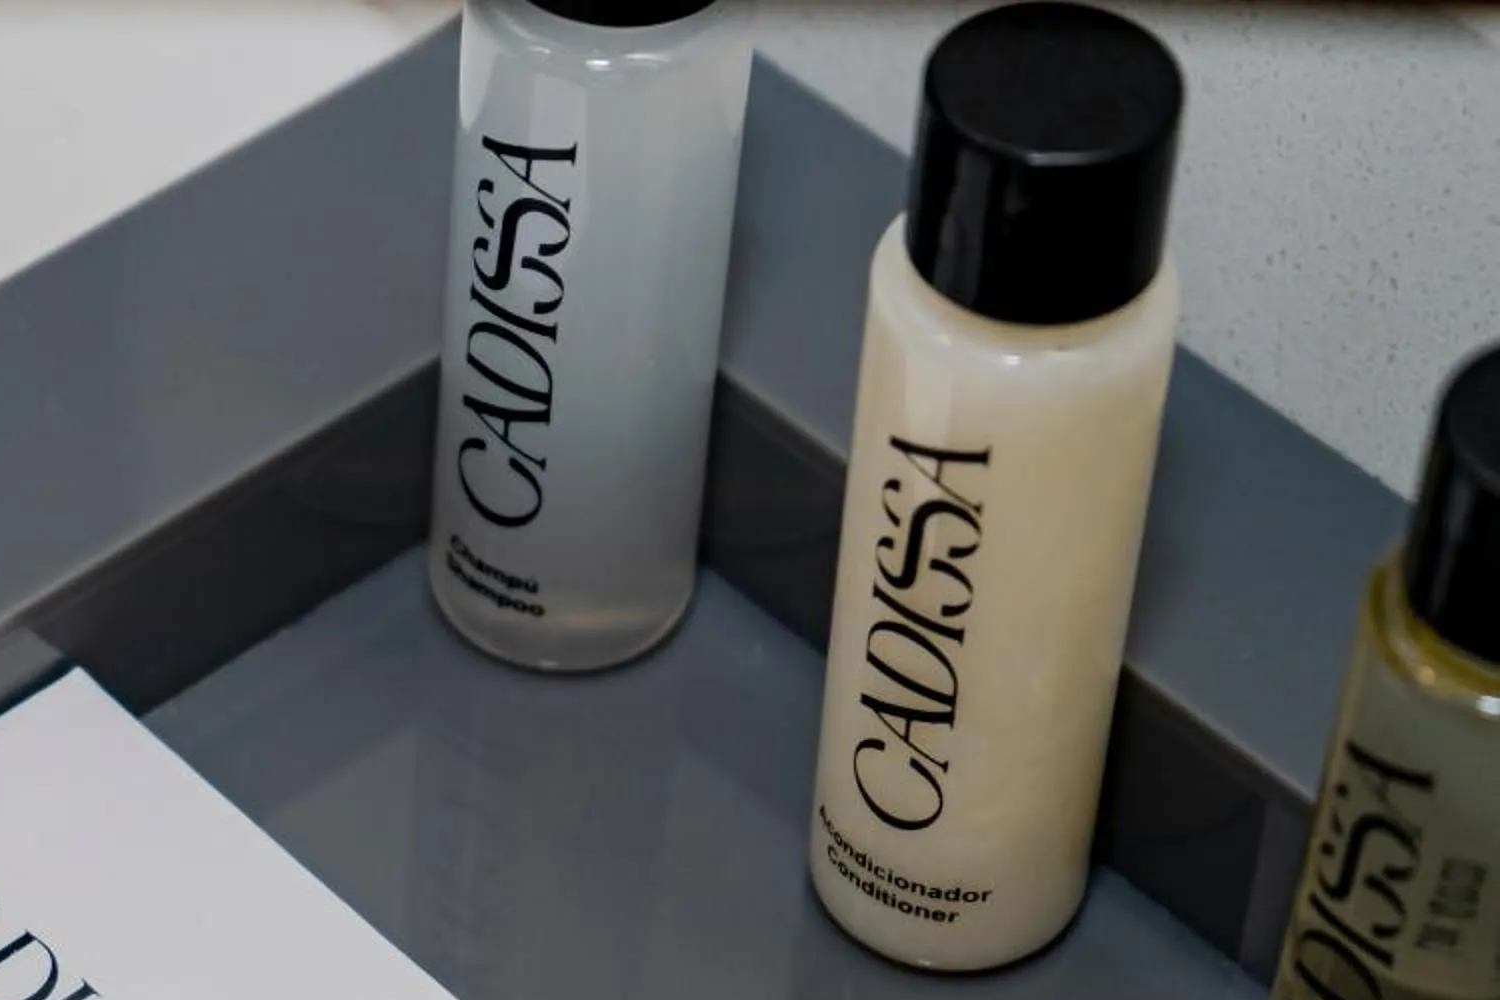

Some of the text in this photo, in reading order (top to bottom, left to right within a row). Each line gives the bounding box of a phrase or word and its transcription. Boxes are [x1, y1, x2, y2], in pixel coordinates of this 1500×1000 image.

[457, 134, 577, 529] CADISSA
[853, 435, 993, 831] CADISSA
[827, 843, 960, 924] Conditioner
